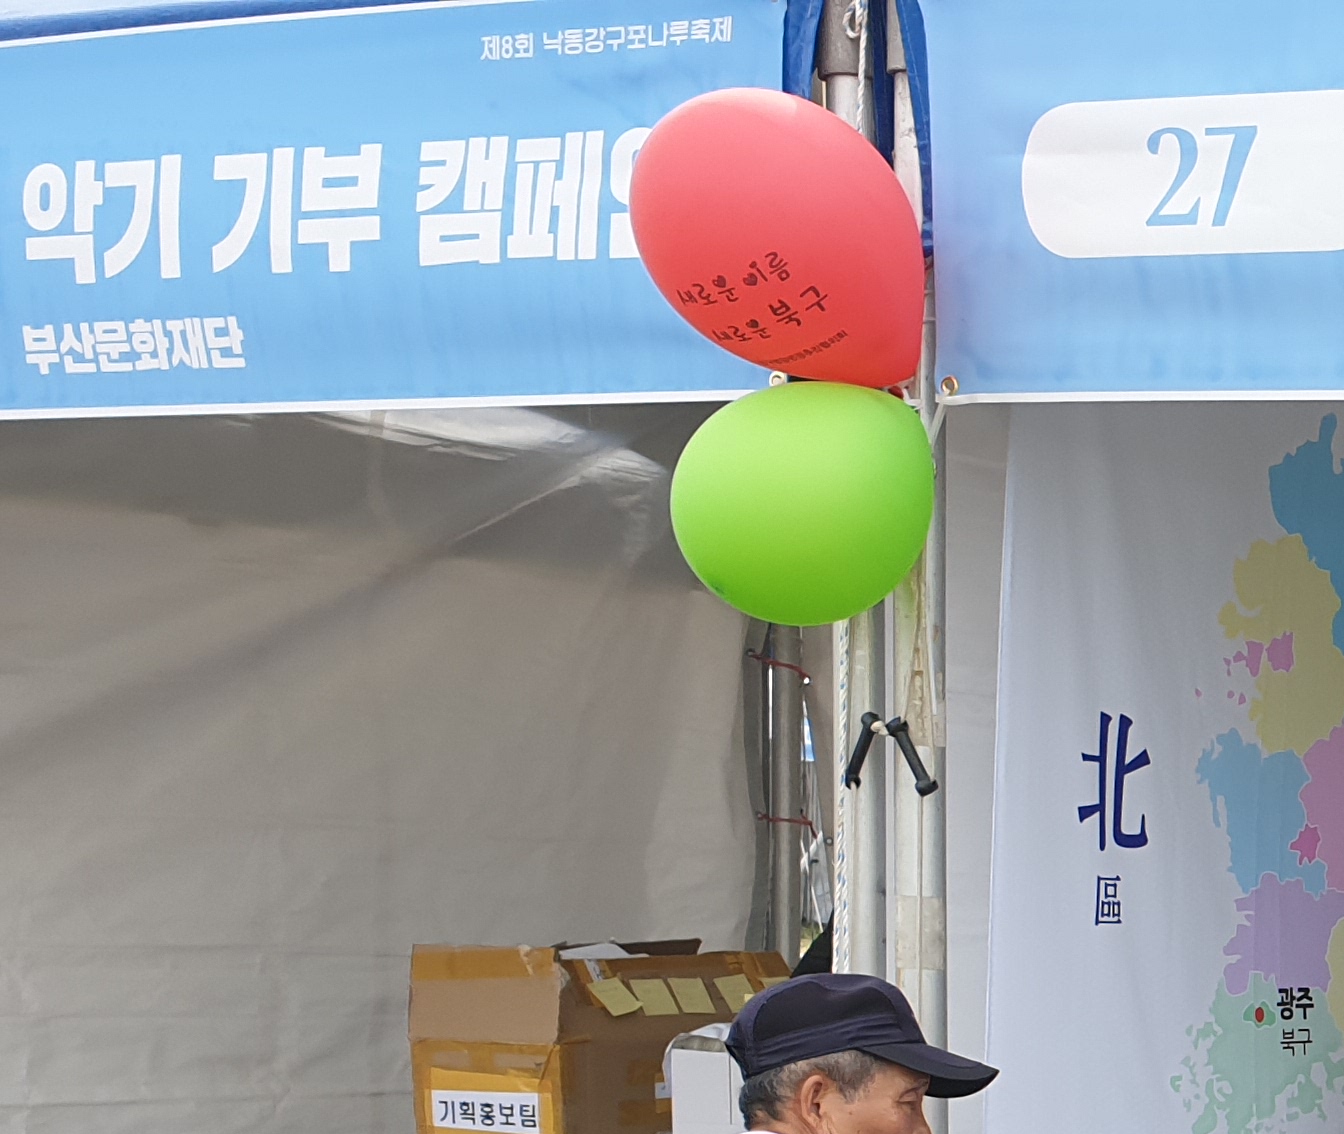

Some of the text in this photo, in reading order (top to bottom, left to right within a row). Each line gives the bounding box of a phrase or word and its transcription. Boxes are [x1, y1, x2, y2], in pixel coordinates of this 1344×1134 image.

[480, 16, 732, 60] 제8회 낙동강구포나루축제
[1144, 125, 1258, 228] 27
[23, 155, 181, 284] 악기
[212, 143, 381, 274] 기부
[677, 252, 790, 306] 새로운 이름
[23, 316, 246, 375] 부산문화재단
[712, 319, 771, 341] 새로운
[1277, 988, 1314, 1020] 광주
[1280, 1029, 1313, 1056] 북구
[439, 1101, 537, 1128] 기획홍보팀
